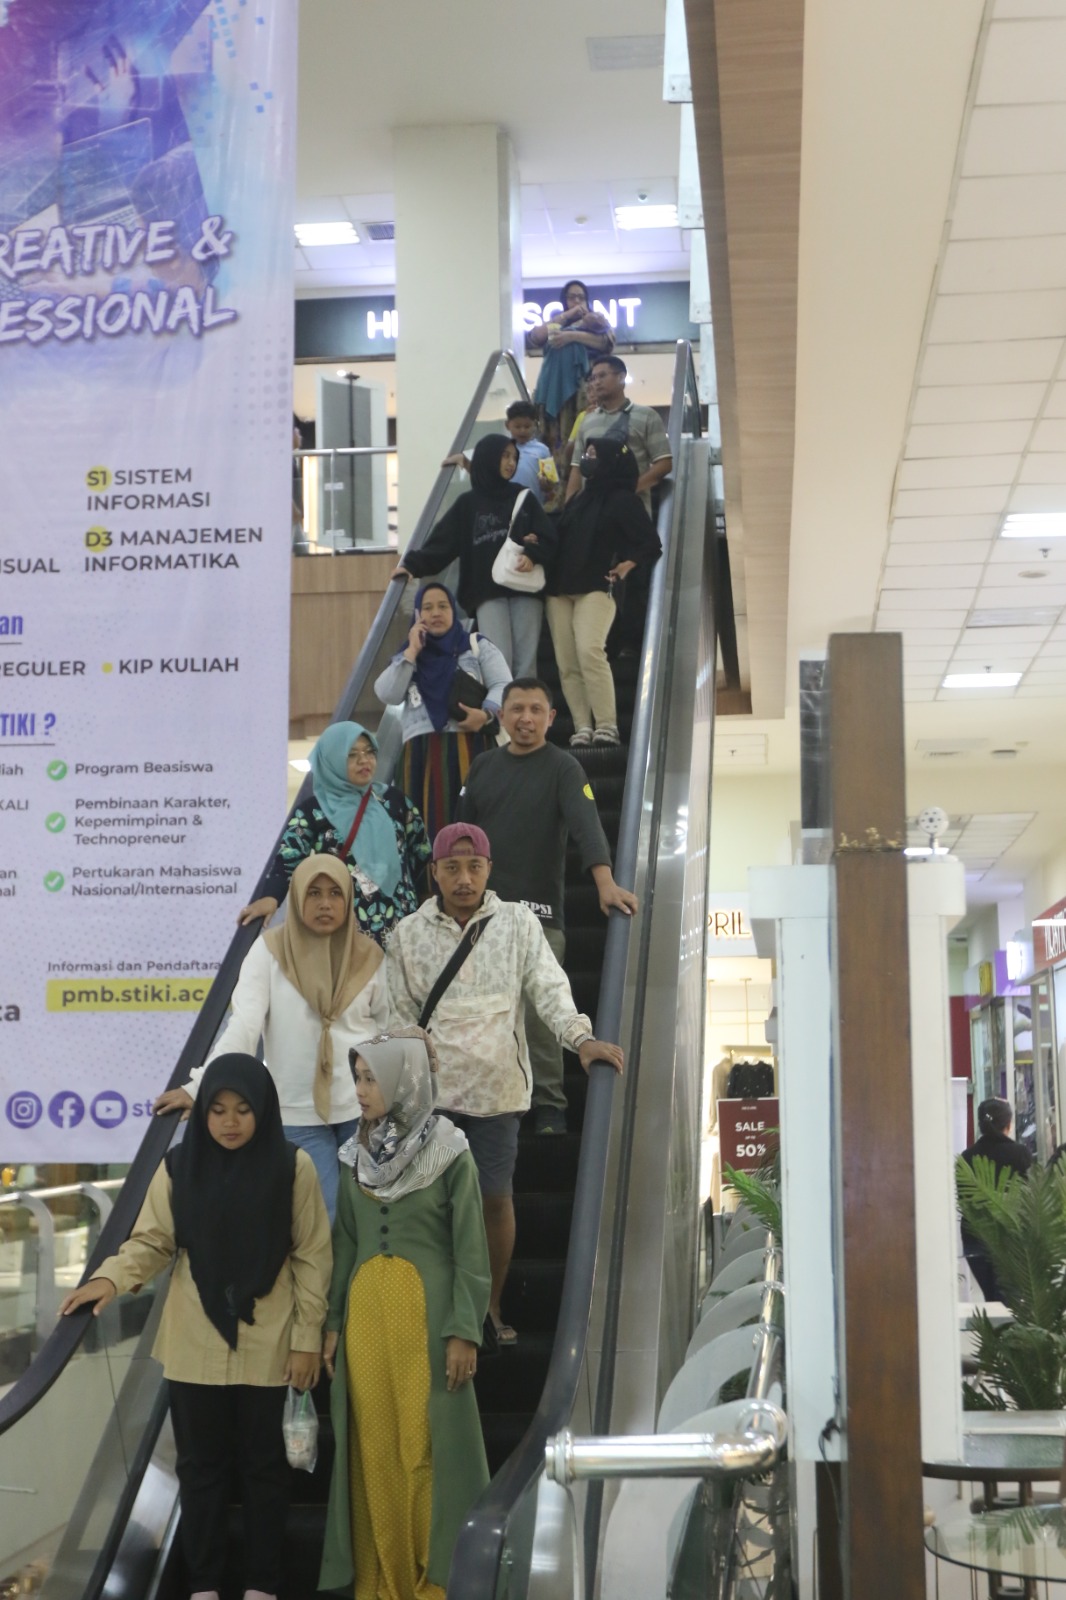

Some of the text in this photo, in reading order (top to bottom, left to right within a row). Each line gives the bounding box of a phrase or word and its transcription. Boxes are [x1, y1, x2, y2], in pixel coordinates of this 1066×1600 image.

[191, 215, 235, 261] &
[0, 284, 238, 342] ESSIONAL
[87, 467, 192, 487] S1 SISTEM
[87, 491, 210, 511] INFORMASI
[85, 527, 263, 548] D3 MANAJEMEN
[84, 552, 240, 572] INFORMATIKA
[0, 661, 86, 677] EGULER
[119, 657, 239, 675] KIP KULIAH
[43, 712, 57, 736] ?
[74, 760, 214, 777] Program Beasiswa
[75, 796, 231, 810] Pembinaan Karakter,
[74, 813, 203, 829] Kepemimpinan &
[74, 832, 186, 847] Technopreneur
[72, 864, 242, 879] Pertukaran Mahasiswa
[71, 881, 238, 897] Nasional/Internasional
[48, 960, 113, 973] Informasi
[116, 960, 142, 971] dan
[62, 984, 204, 1007] pmb.stiki.ac
[735, 1121, 765, 1133] SALE
[735, 1143, 767, 1158] 50%
